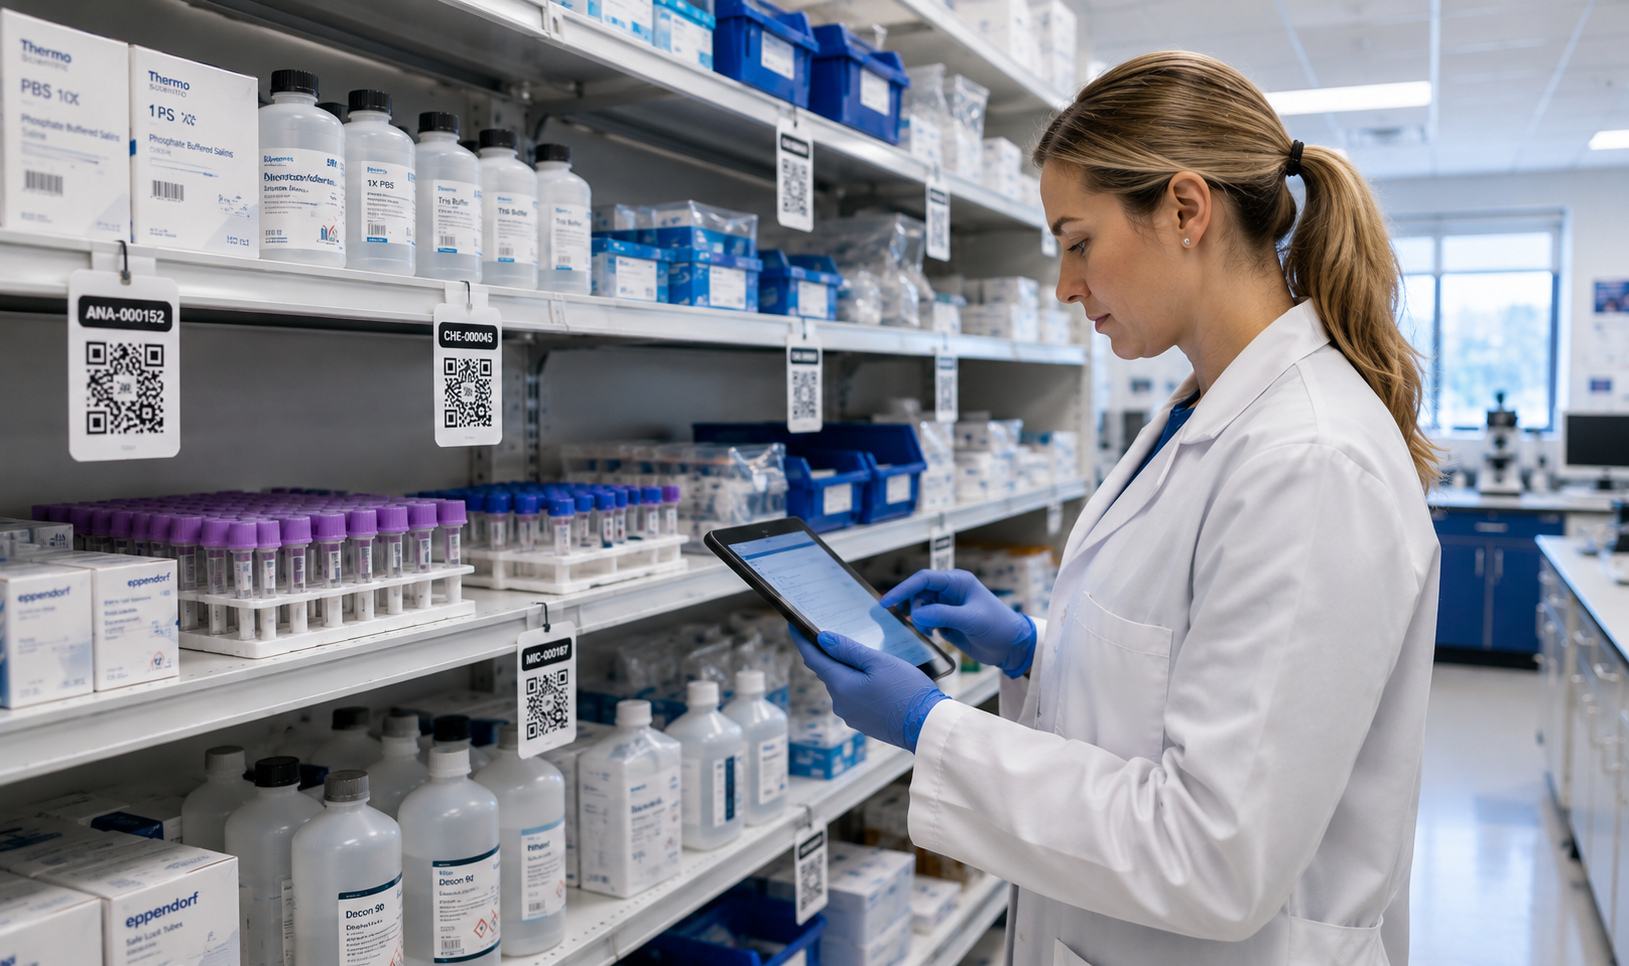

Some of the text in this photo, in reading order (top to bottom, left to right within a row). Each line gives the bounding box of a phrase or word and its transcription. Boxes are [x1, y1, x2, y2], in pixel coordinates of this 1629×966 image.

[20, 38, 72, 64] Thermo
[21, 78, 52, 99] PBS
[147, 70, 190, 91] Thermo
[21, 113, 64, 131] Phosphate
[149, 133, 186, 149] Phosphate
[85, 305, 165, 324] ANA-000152
[443, 330, 493, 343] CHE-000045
[128, 572, 171, 588] eppendorf
[18, 585, 71, 604] eppendorf
[126, 891, 198, 929] eppendorf
[346, 907, 374, 919] Decon
